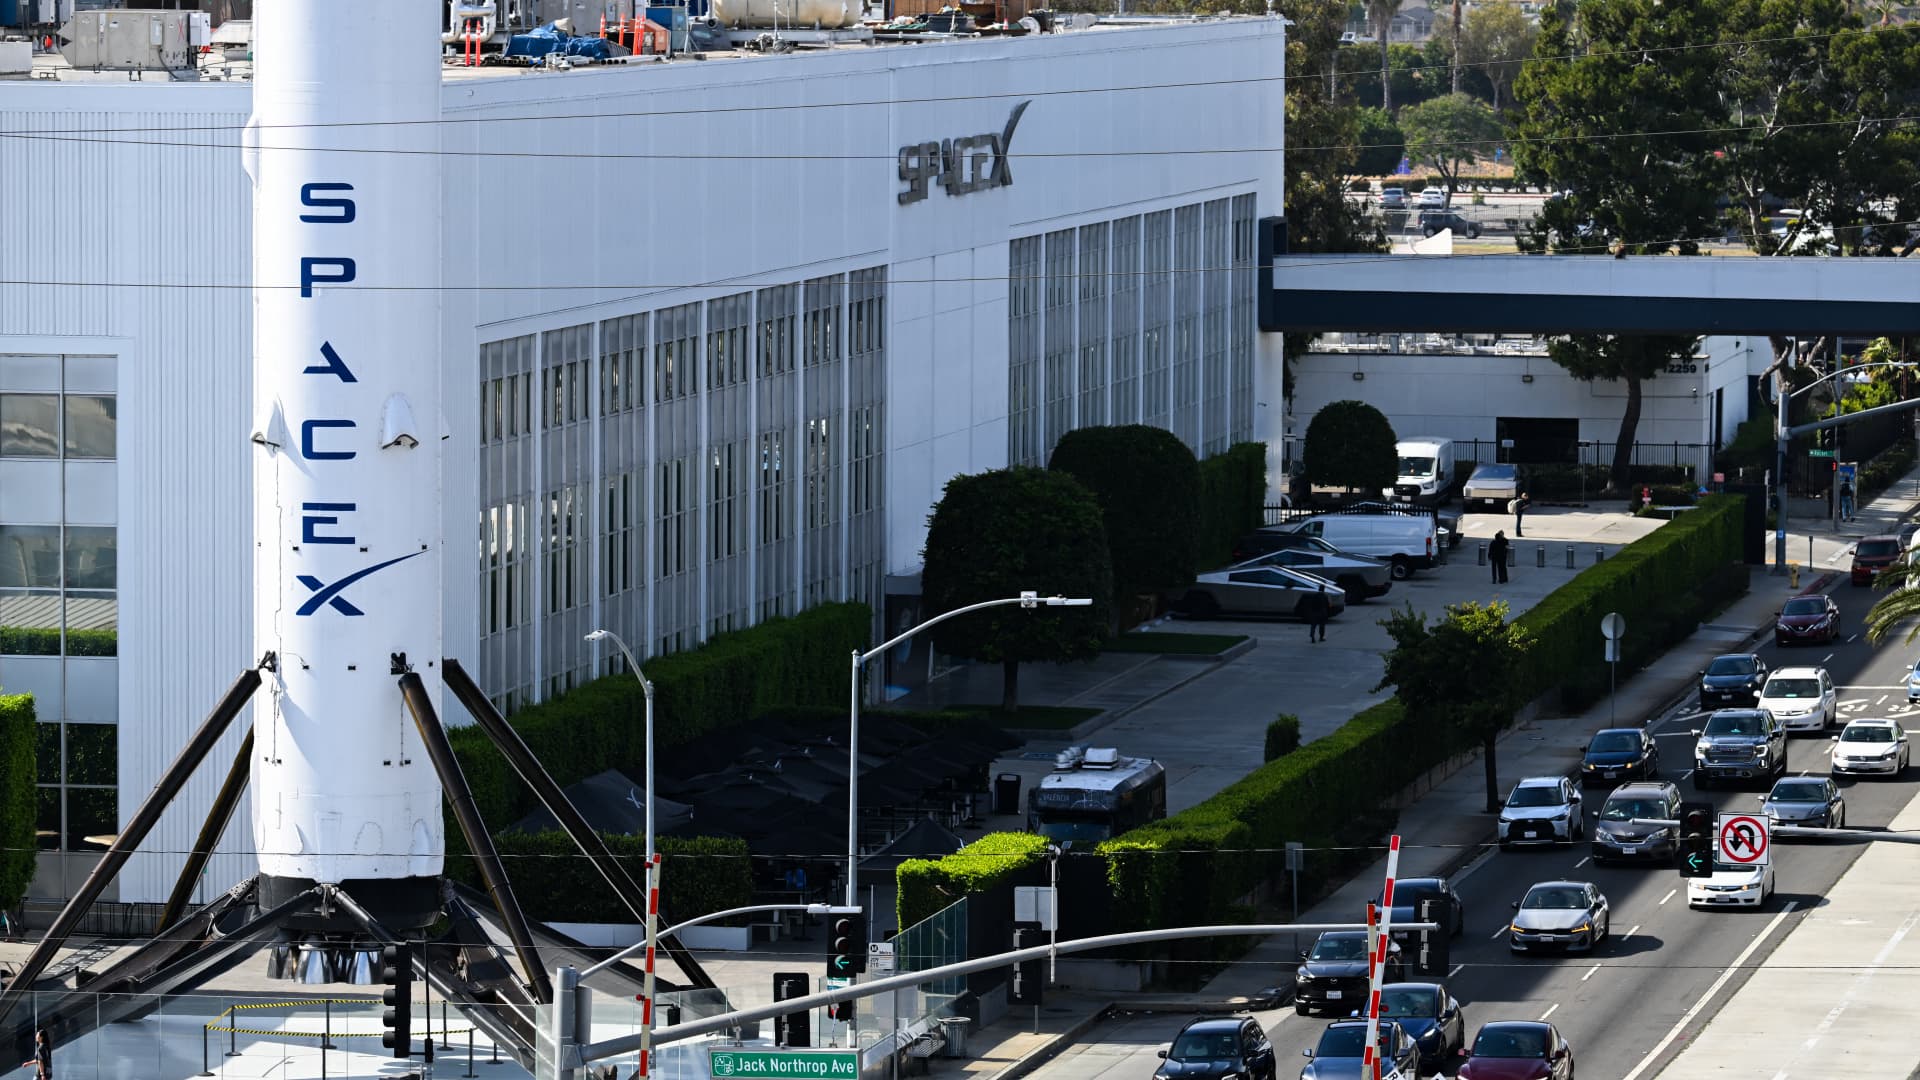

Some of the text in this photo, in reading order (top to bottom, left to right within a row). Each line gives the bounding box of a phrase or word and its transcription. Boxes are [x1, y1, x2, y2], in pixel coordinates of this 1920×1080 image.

[898, 100, 1032, 205] SPACEX
[295, 182, 432, 617] SPACEX
[736, 1057, 855, 1076] Jack Northrop Ave
